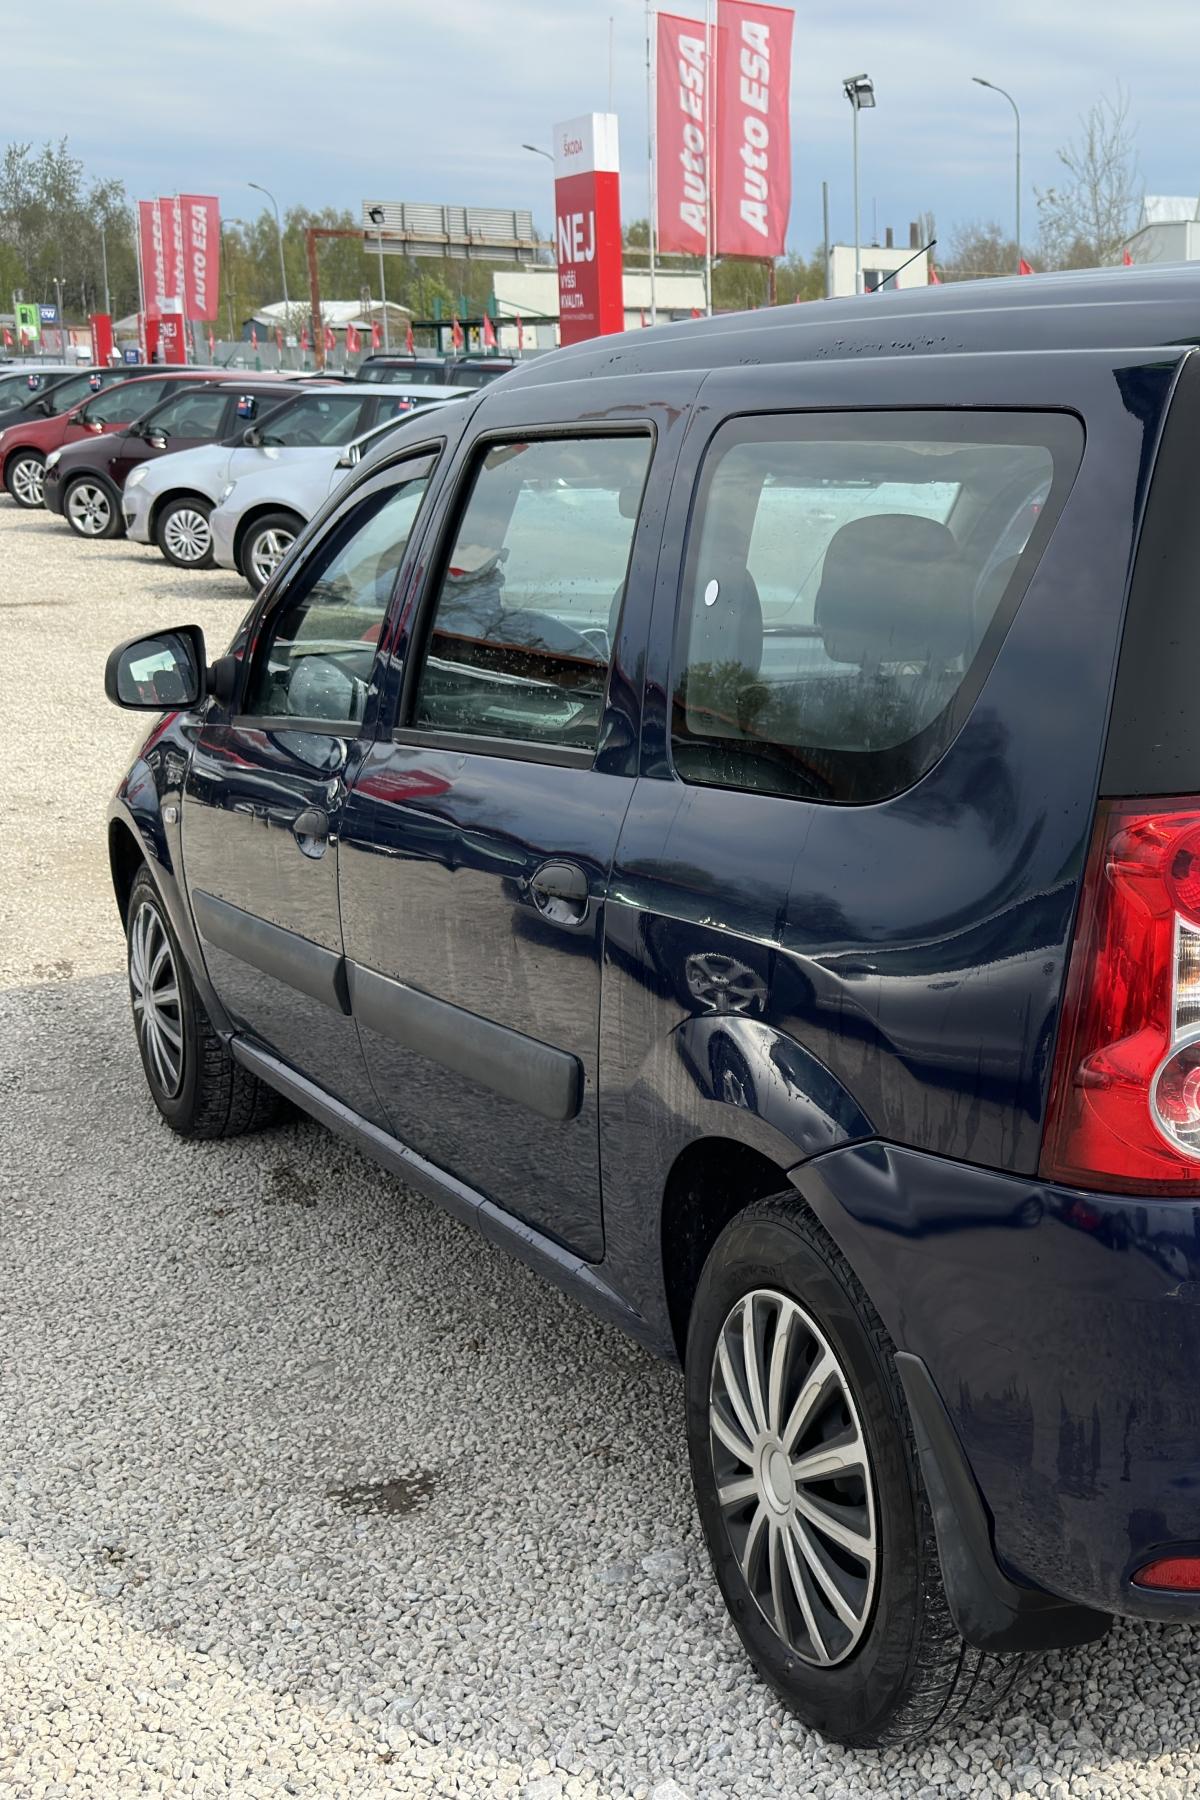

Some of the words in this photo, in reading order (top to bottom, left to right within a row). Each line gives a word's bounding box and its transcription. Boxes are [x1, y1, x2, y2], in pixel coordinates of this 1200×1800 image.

[679, 34, 706, 122] ESA
[740, 20, 770, 114] ESA
[680, 122, 707, 237] Auto
[740, 116, 769, 237] Auto
[191, 204, 208, 250] ESA
[558, 211, 595, 265] NEJ
